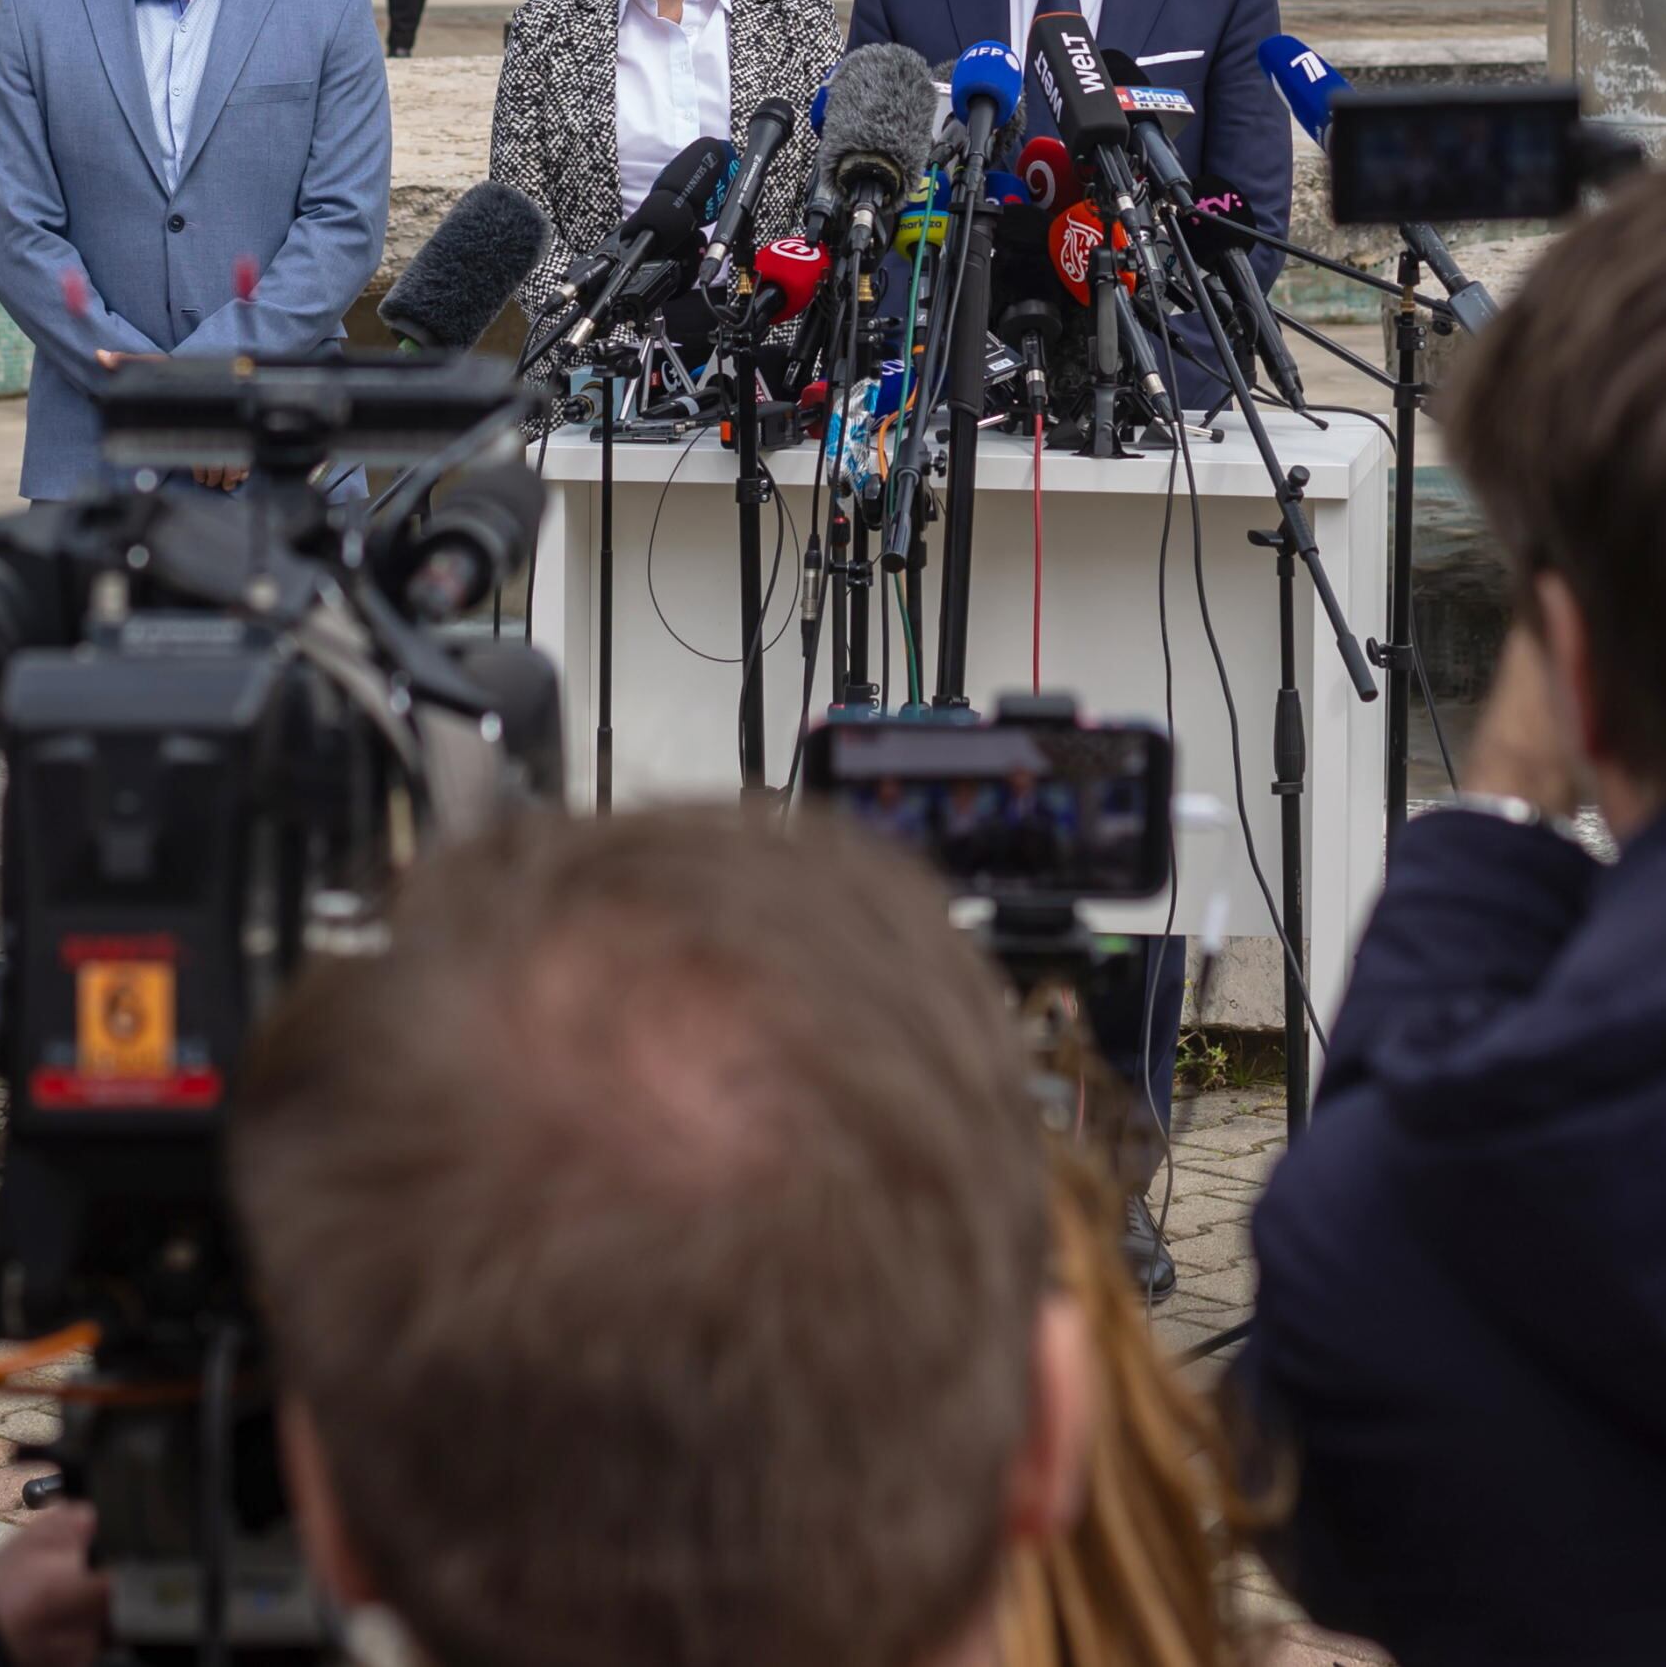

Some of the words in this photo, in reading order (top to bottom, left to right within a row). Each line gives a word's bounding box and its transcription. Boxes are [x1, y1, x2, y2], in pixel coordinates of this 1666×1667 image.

[963, 47, 1005, 61] AFP
[1130, 88, 1186, 103] Prima
[899, 218, 942, 231] markza
